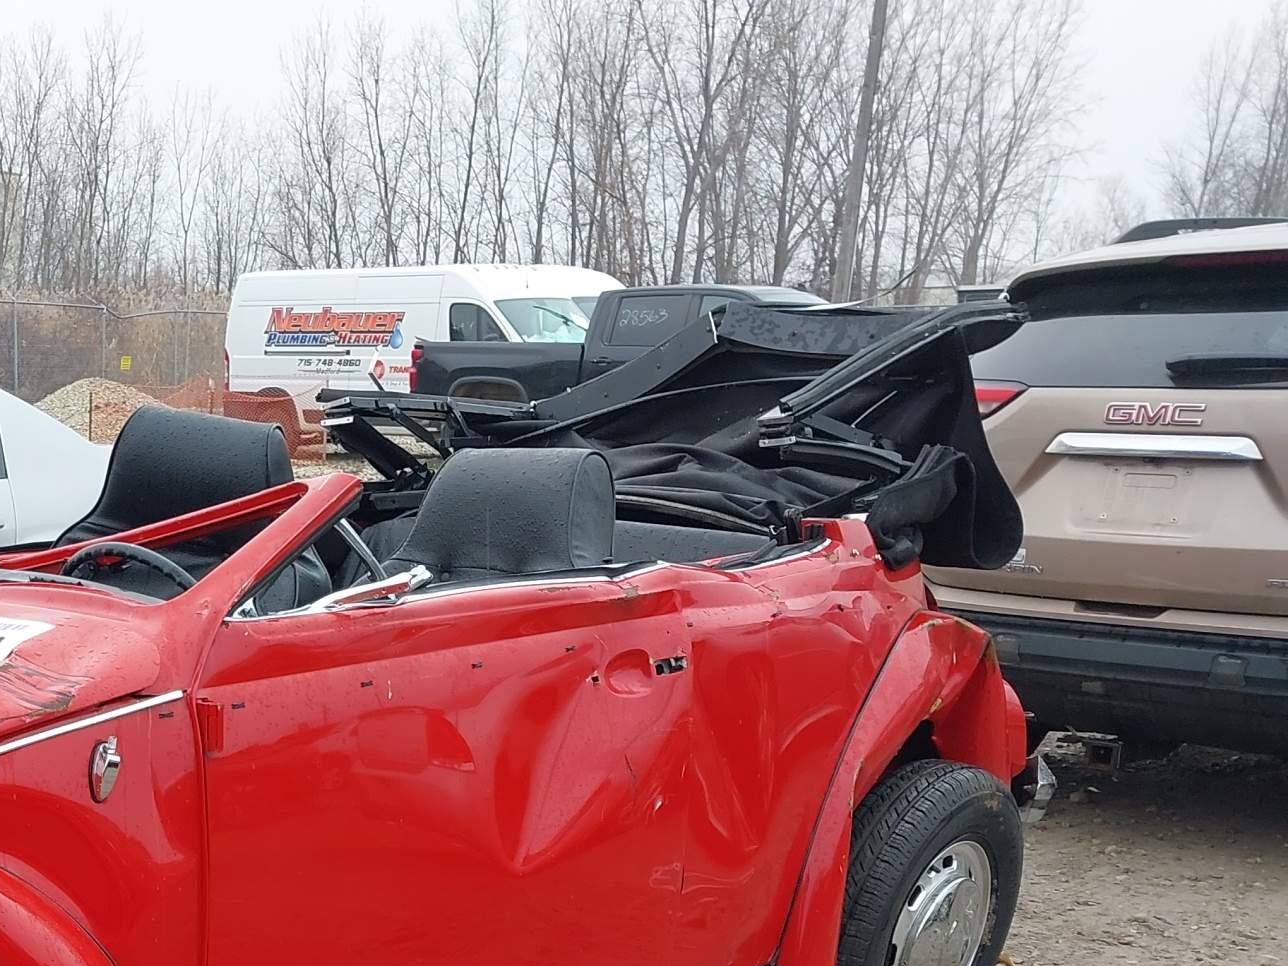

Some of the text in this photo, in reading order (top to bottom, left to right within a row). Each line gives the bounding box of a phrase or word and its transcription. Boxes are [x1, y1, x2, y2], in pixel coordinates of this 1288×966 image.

[264, 306, 405, 334] Neubauer
[265, 332, 327, 347] PLUMBING
[335, 332, 392, 347] HEATING
[389, 366, 411, 374] TRAN
[1104, 402, 1206, 425] GMC
